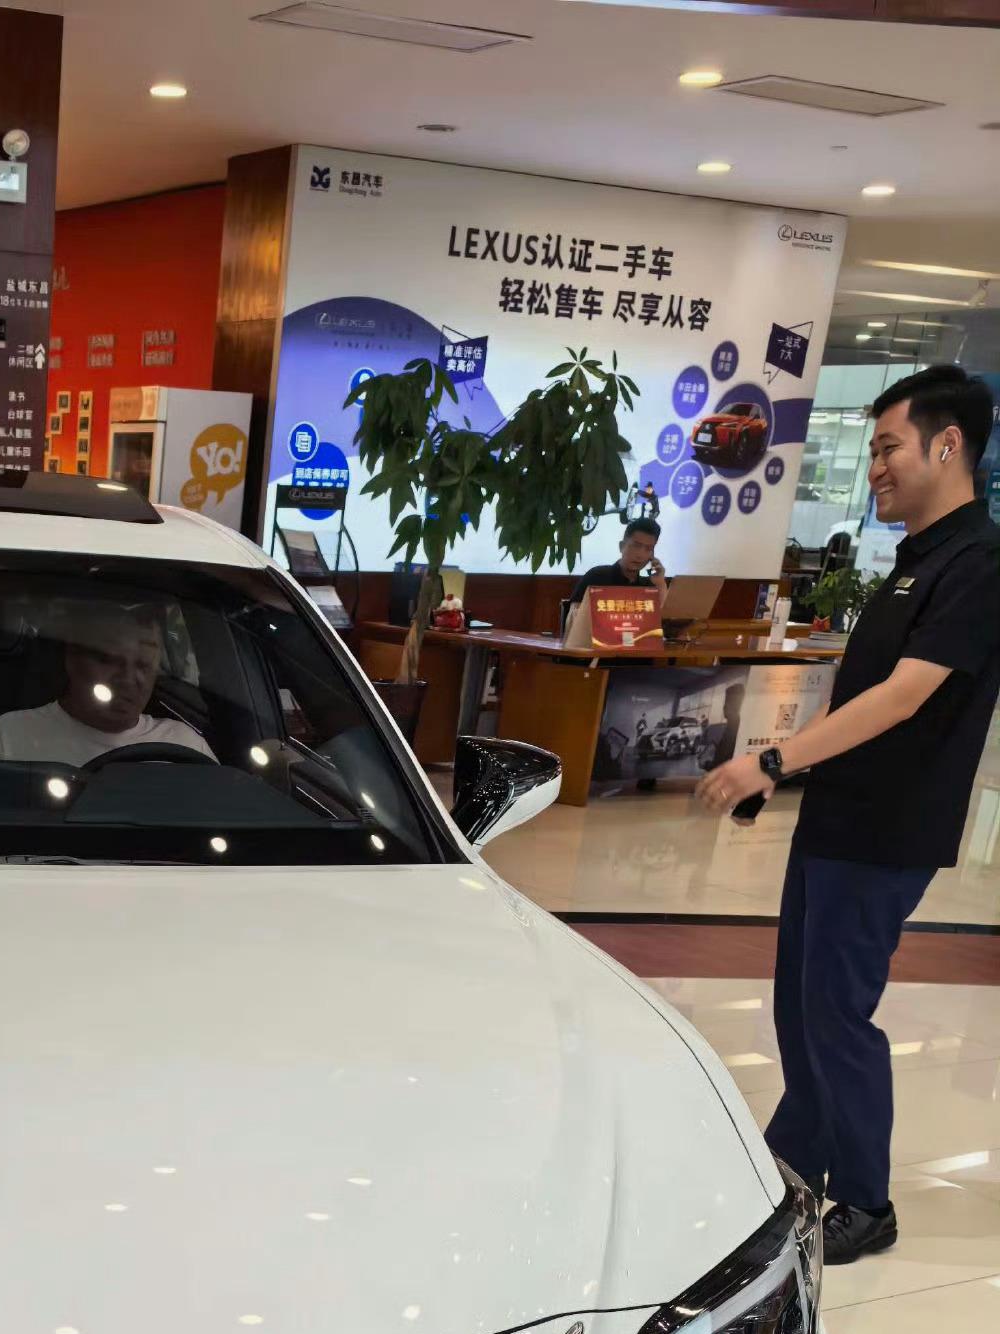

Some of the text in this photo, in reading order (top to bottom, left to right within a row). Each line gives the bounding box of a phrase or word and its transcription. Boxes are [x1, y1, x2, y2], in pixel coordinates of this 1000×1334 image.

[340, 170, 383, 188] 东昌汽车
[793, 230, 833, 243] LEXUS
[448, 225, 674, 281] LEXUS认证二手车
[6, 279, 48, 294] 盐城东昌
[499, 277, 712, 331] 轻松售车 尽享从容
[444, 345, 482, 360] 精准评估
[8, 356, 34, 368] 休闲区
[447, 360, 476, 373] 卖高价
[197, 440, 244, 477] YO!
